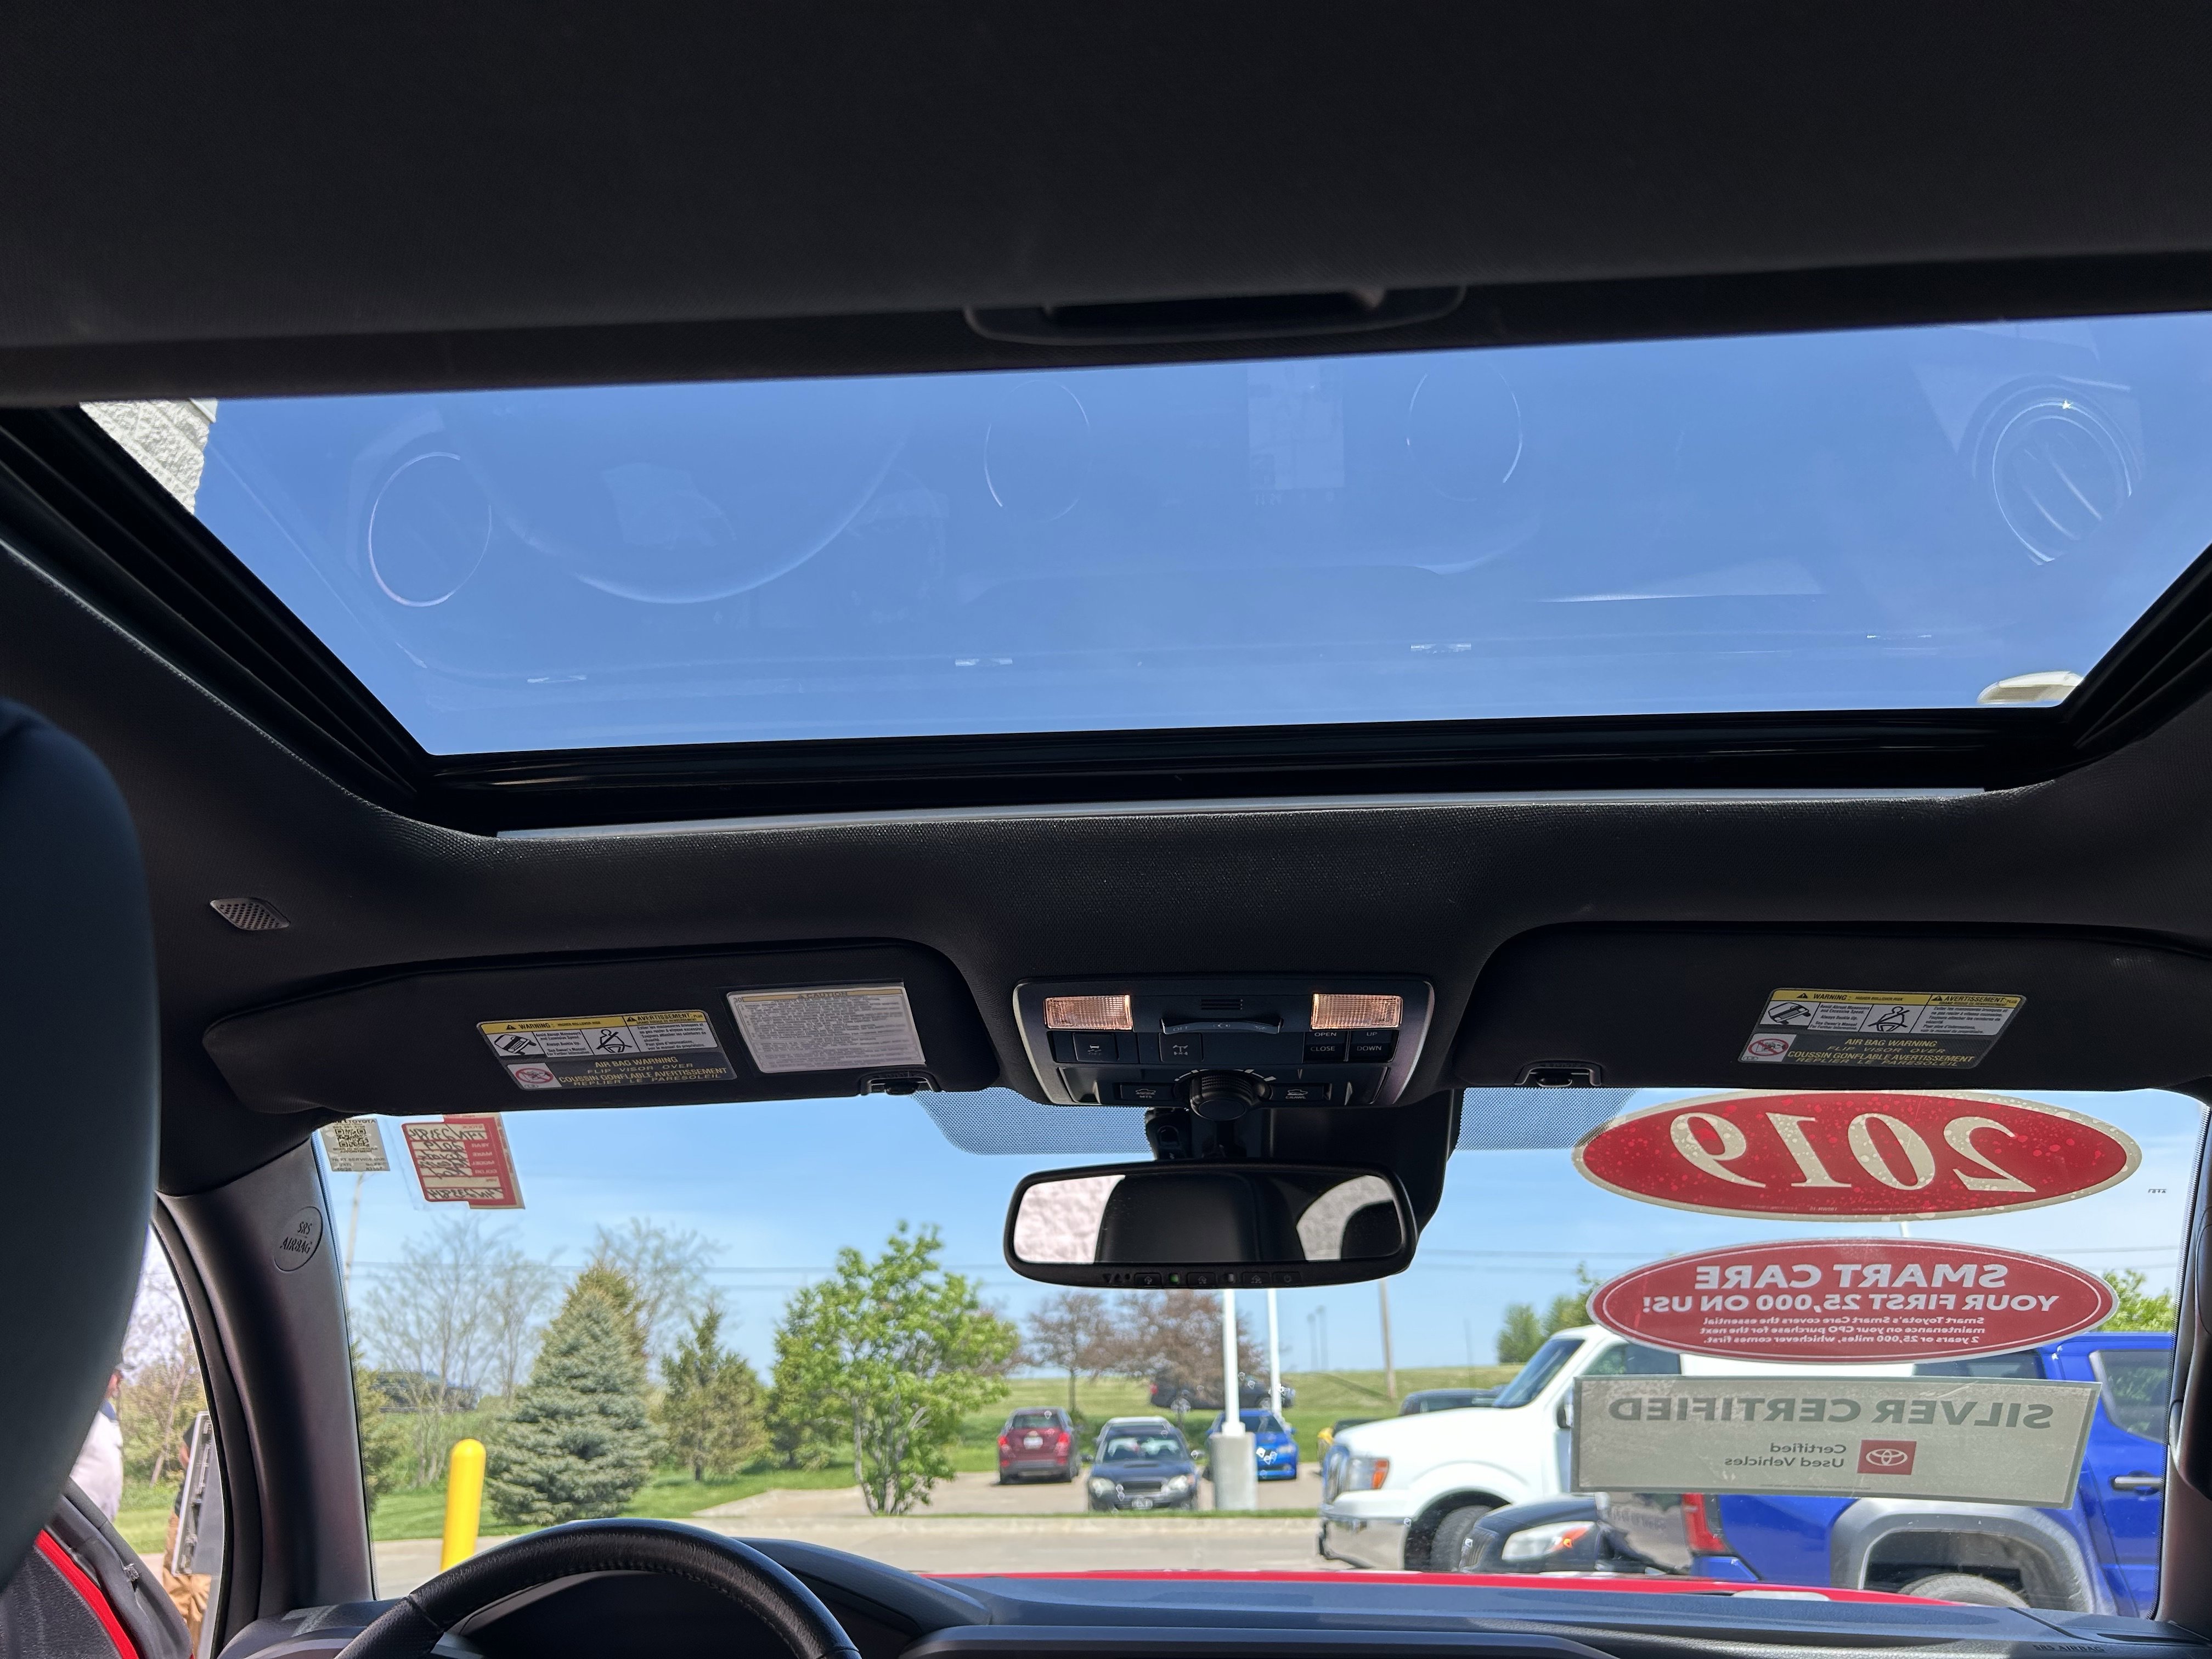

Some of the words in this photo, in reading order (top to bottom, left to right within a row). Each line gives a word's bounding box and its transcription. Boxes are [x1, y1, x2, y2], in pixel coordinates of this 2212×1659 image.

[632, 1057, 679, 1065] WARNING
[1832, 1052, 1893, 1060] GONFLABLE
[1891, 1054, 1975, 1063] AVERTISSEMENT
[558, 1075, 600, 1083] COUSSIN
[600, 1071, 652, 1080] GONFLABLE
[652, 1068, 727, 1077] AVERTISSEMENT
[652, 1074, 721, 1082] PARESOLEIL
[297, 1221, 312, 1234] SRS
[280, 1236, 313, 1254] AIRBAG
